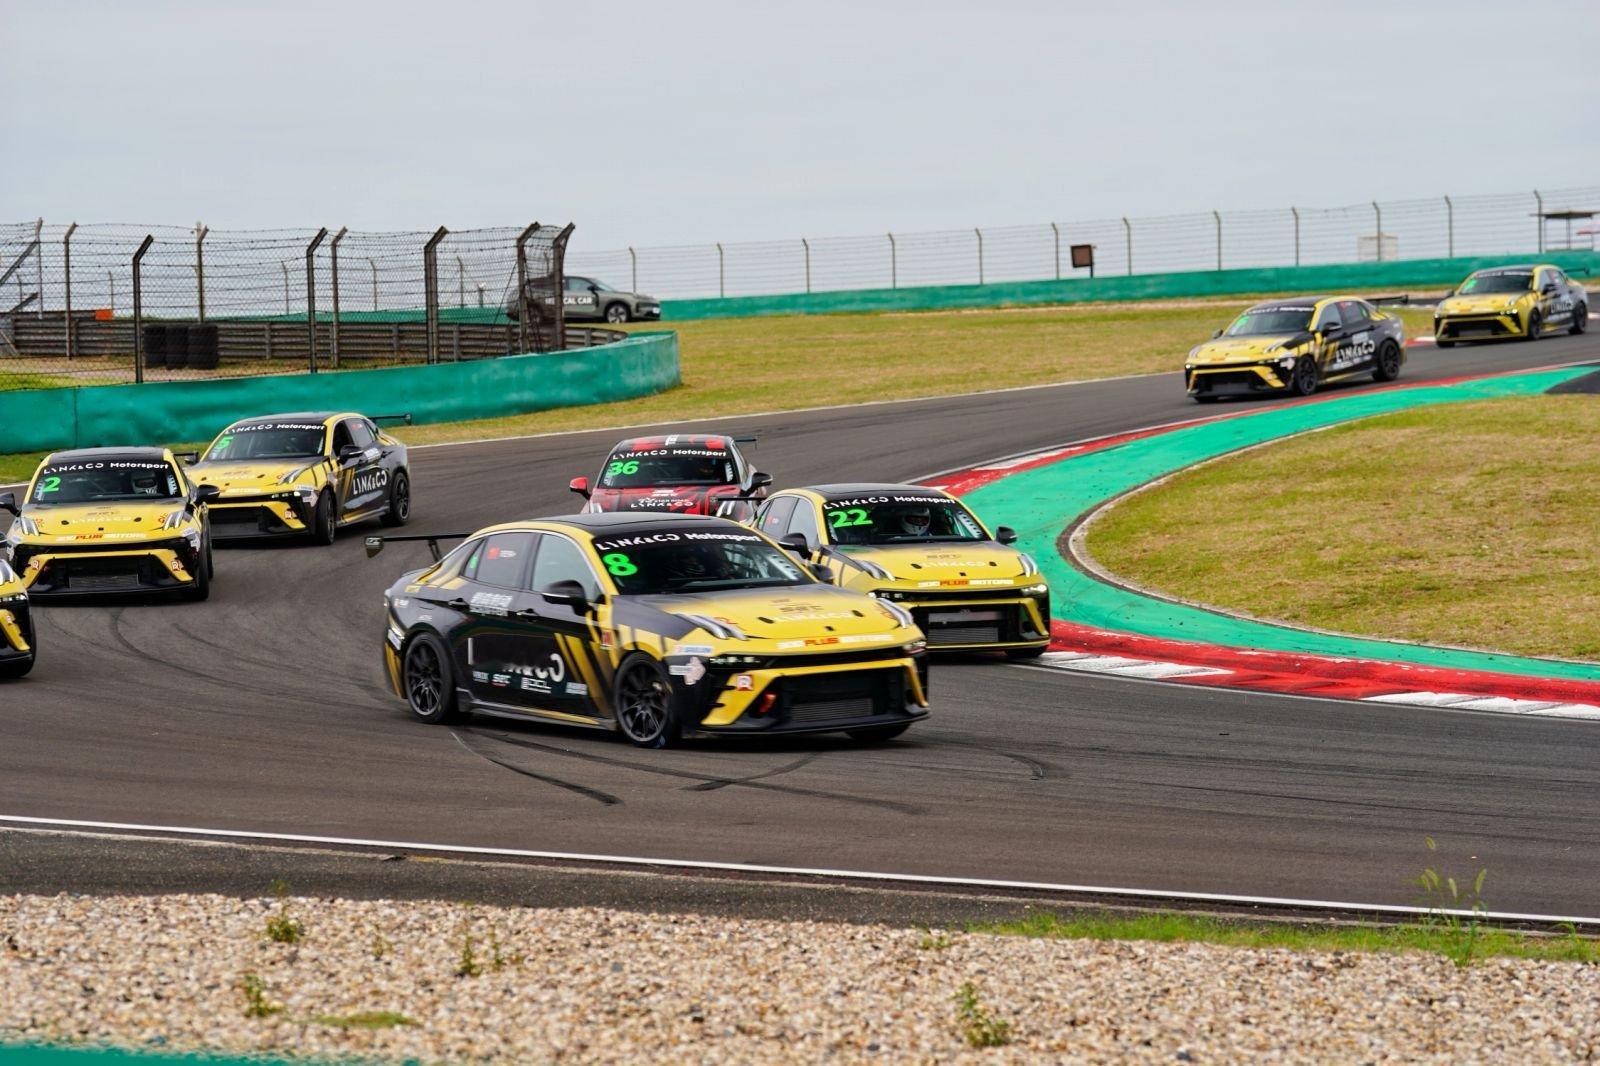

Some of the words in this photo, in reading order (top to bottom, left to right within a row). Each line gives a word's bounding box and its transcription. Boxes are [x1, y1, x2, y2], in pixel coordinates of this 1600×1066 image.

[673, 449, 727, 457] Motorsport
[110, 462, 169, 470] Motorsport
[609, 460, 639, 476] 36
[42, 476, 61, 493] 2
[894, 496, 956, 504] Motorsport
[828, 509, 873, 528] 22
[684, 533, 762, 542] Motorsport
[602, 553, 638, 576] 8
[804, 636, 840, 647] PLUS
